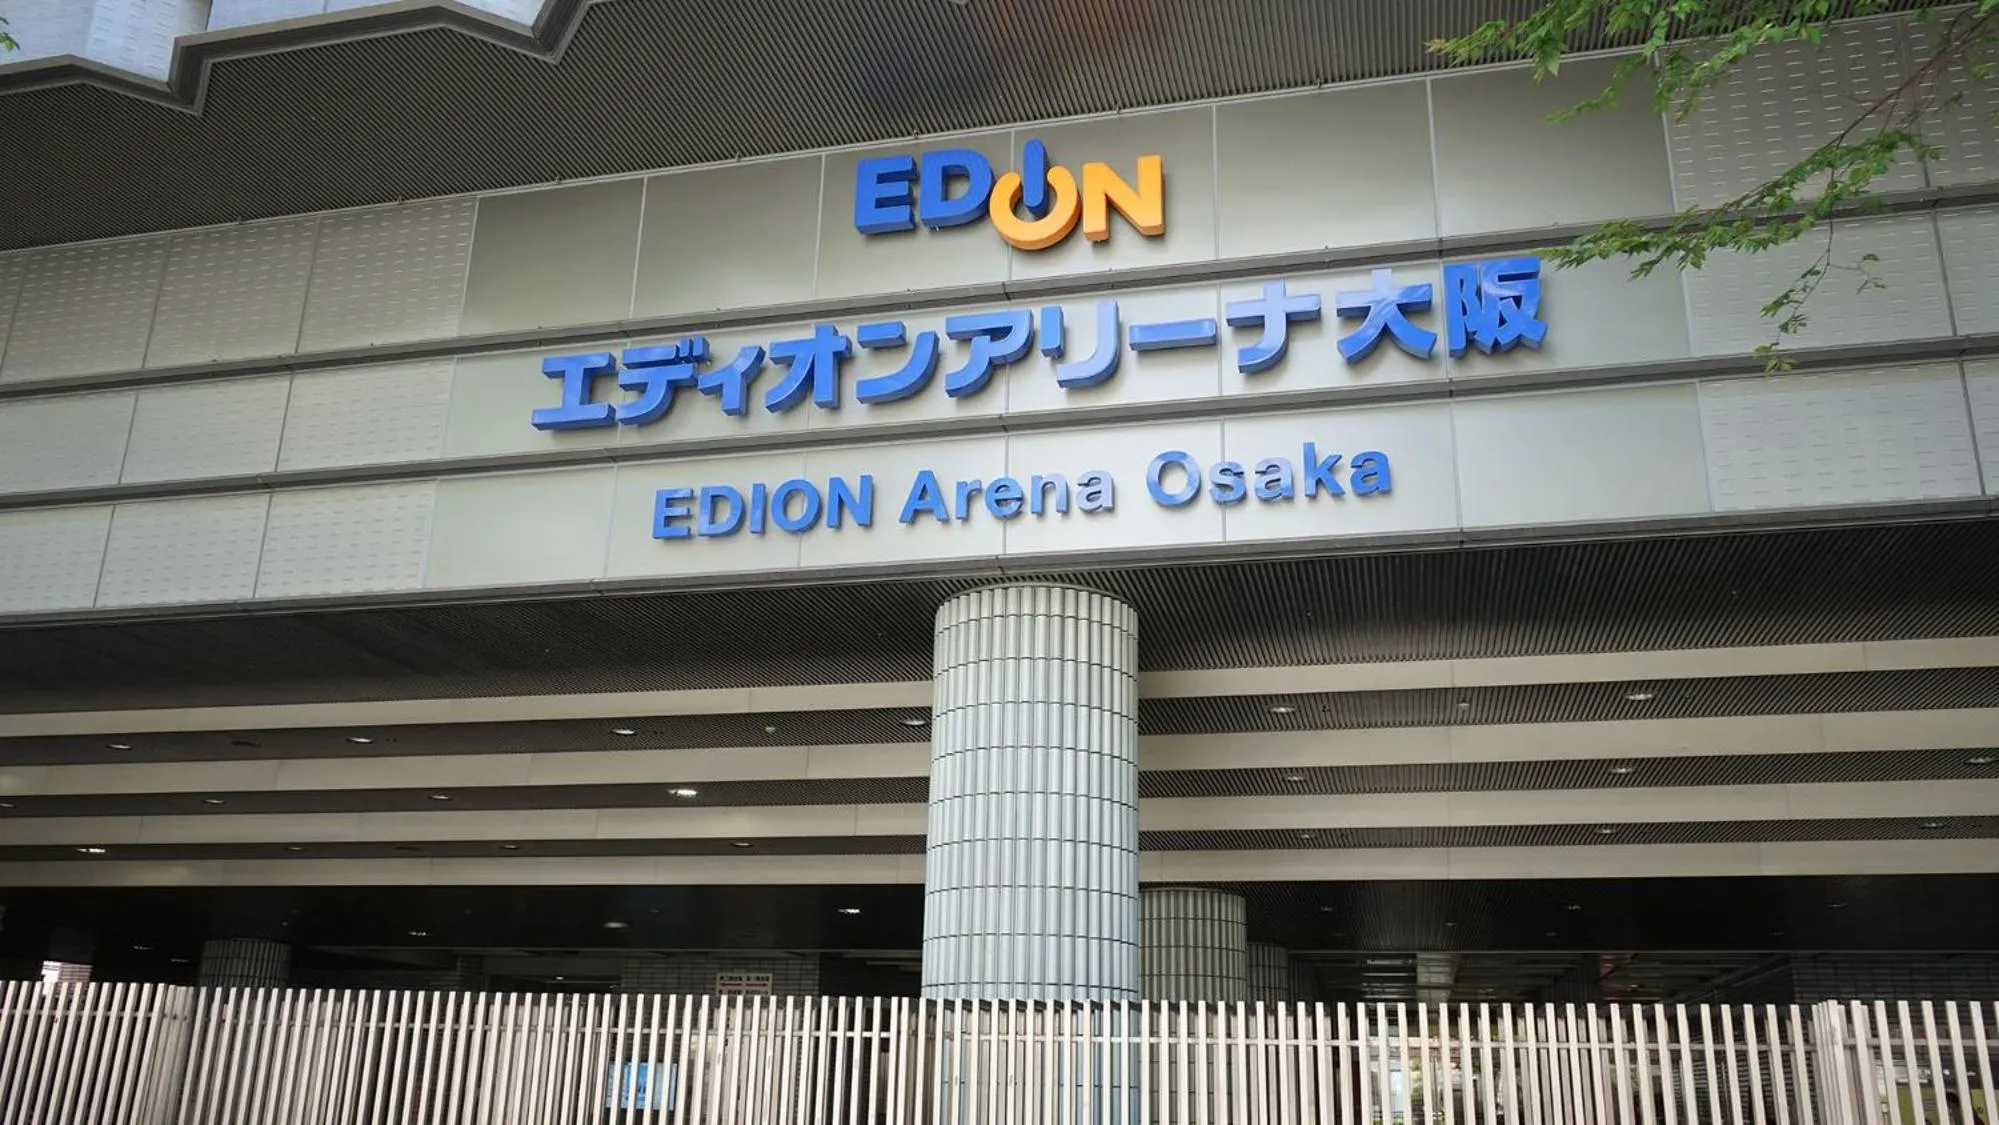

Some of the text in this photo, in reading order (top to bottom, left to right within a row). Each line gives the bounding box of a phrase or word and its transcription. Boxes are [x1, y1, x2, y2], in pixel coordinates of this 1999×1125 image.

[853, 139, 1165, 250] EDION
[531, 256, 1547, 430] エディオンアリーナ大阪
[651, 440, 1393, 541] EDION Arena Osaka
